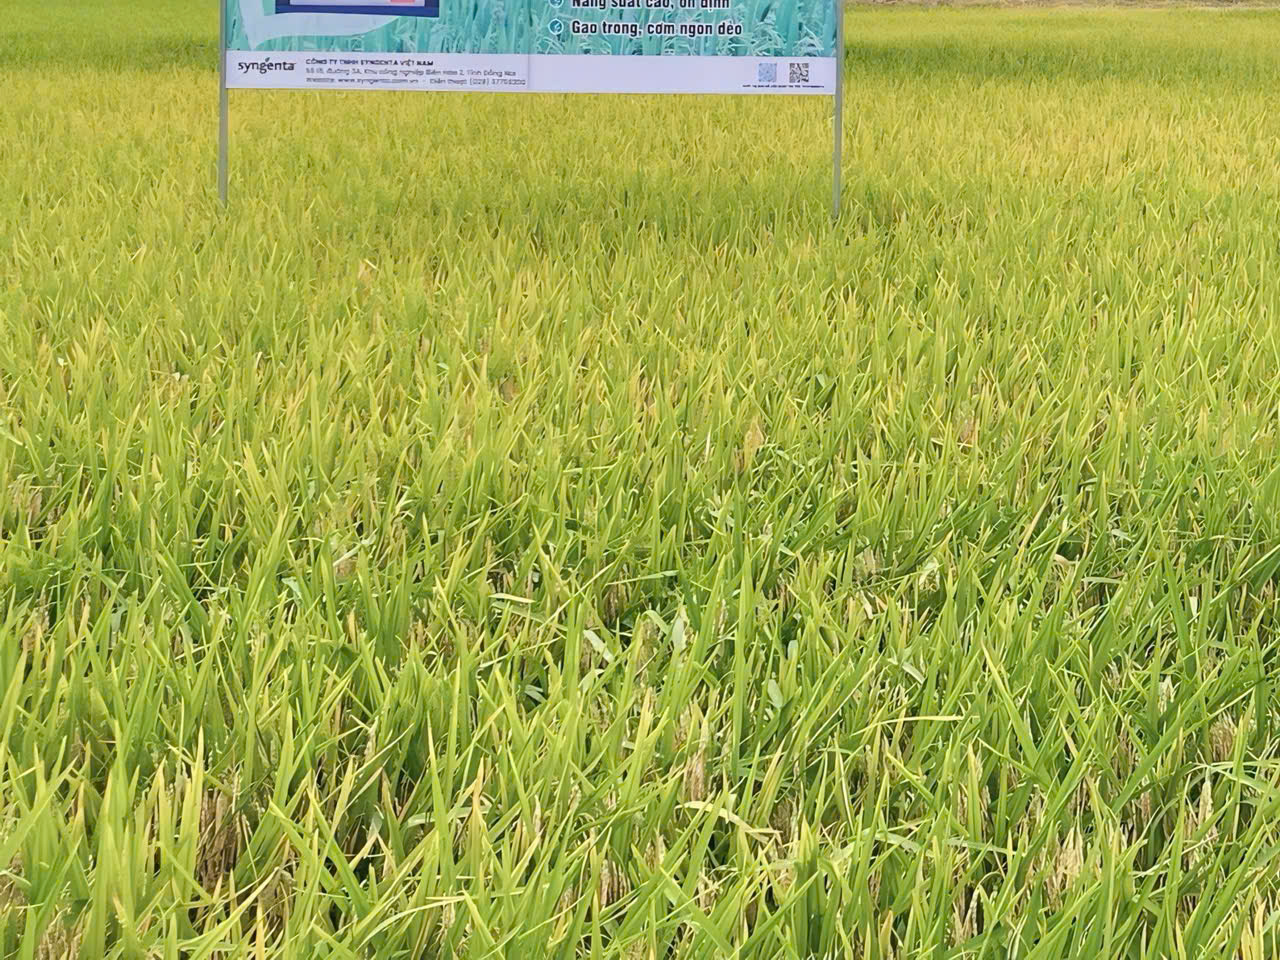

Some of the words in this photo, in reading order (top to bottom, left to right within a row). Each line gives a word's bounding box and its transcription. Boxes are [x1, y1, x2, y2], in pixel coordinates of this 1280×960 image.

[602, 21, 642, 37] trong,
[647, 22, 674, 34] cơm
[680, 24, 713, 37] ngon
[238, 60, 294, 74] syngenta
